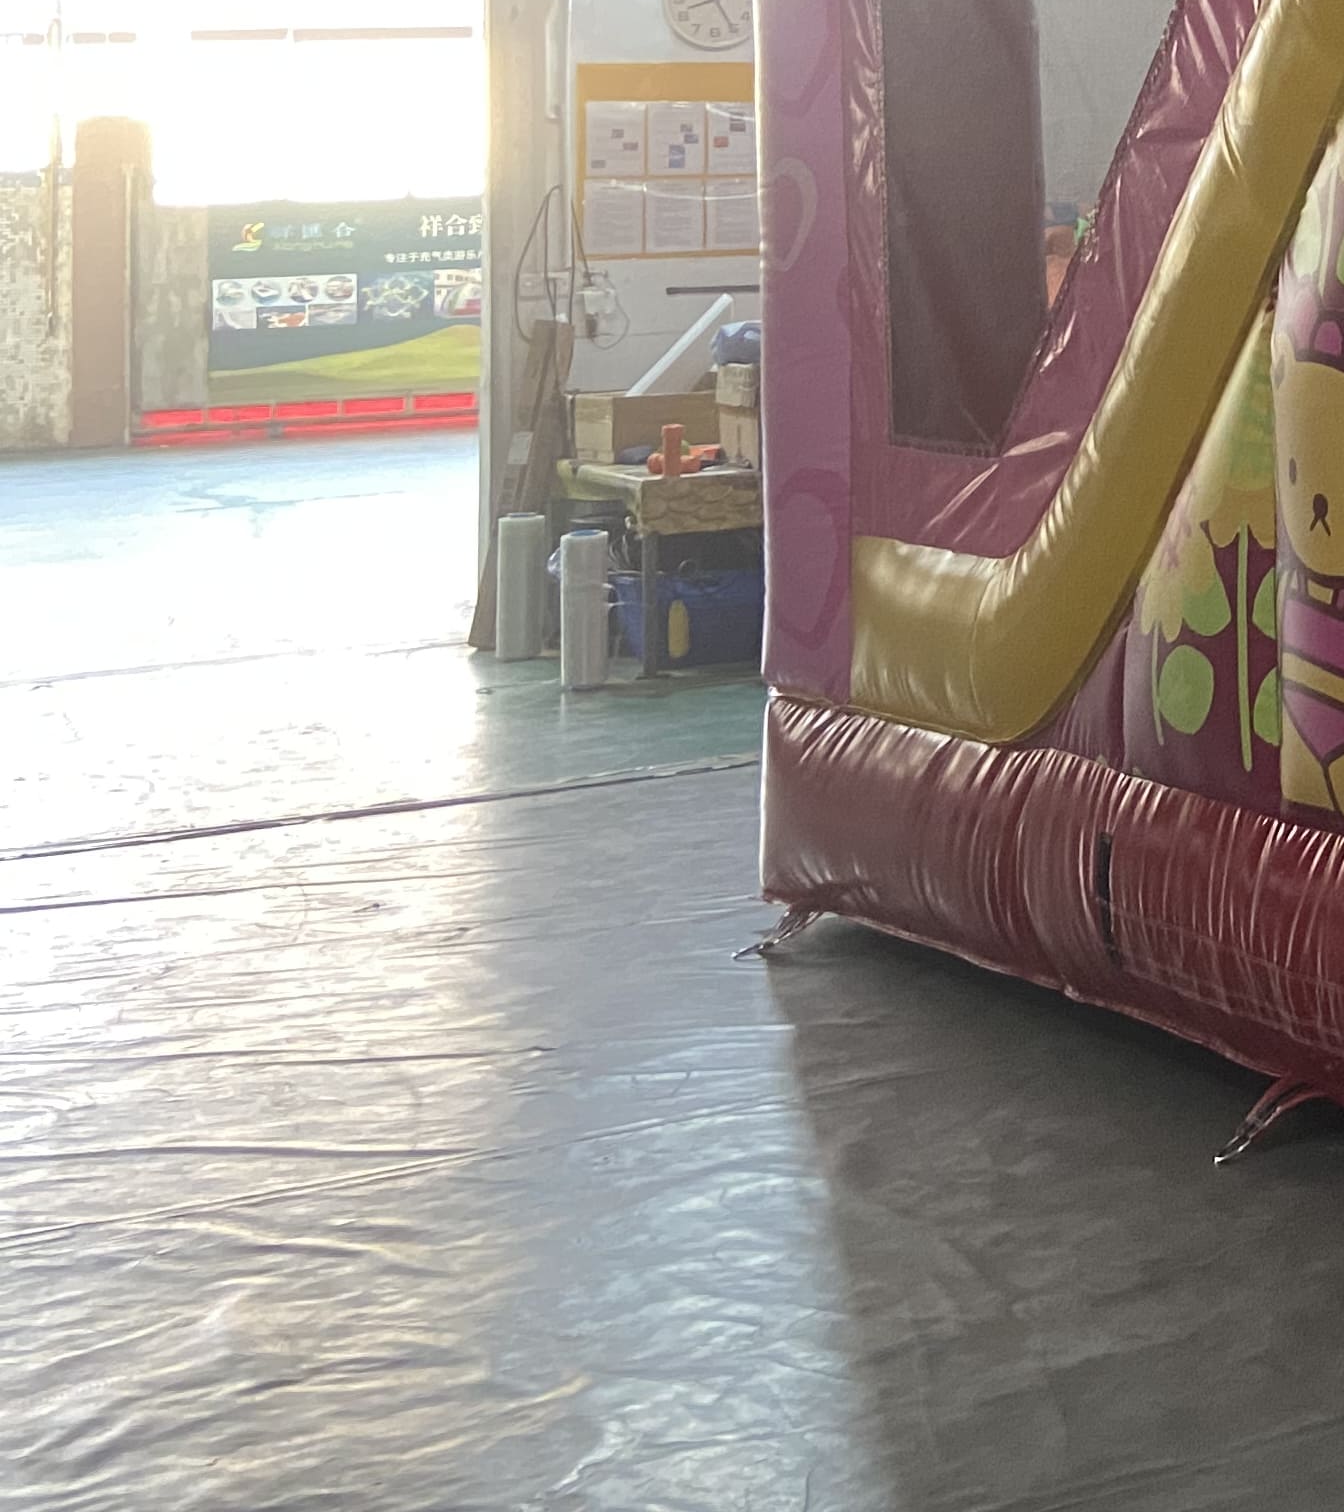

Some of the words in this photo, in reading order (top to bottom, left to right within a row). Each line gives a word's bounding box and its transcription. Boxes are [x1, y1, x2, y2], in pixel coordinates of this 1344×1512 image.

[677, 10, 689, 22] 8
[740, 11, 750, 21] 4
[690, 23, 702, 35] 7
[709, 27, 721, 38] 6
